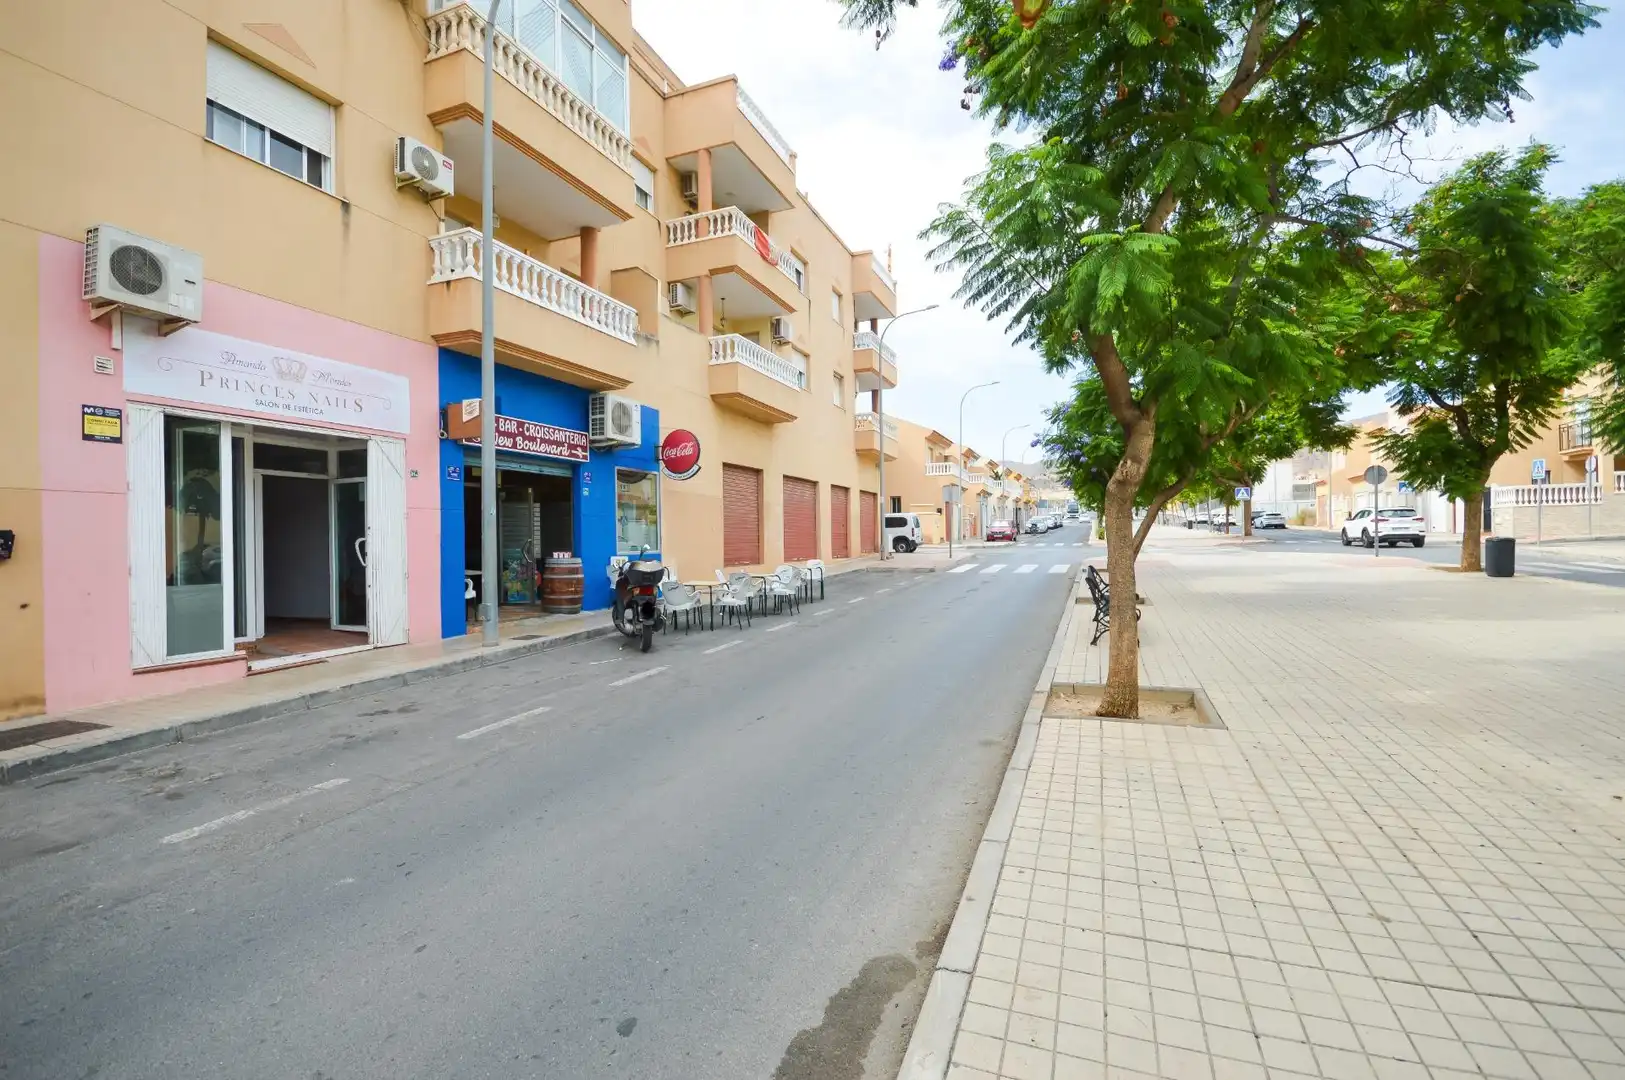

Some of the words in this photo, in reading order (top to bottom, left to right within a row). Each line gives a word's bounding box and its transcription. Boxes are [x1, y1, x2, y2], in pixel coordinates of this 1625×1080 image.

[199, 370, 296, 400] PRINCES
[308, 391, 363, 413] NAILS
[282, 403, 292, 411] DE
[498, 417, 518, 434] BAR
[524, 423, 587, 447] CROISSANTERIA
[515, 436, 571, 456] Boulevard
